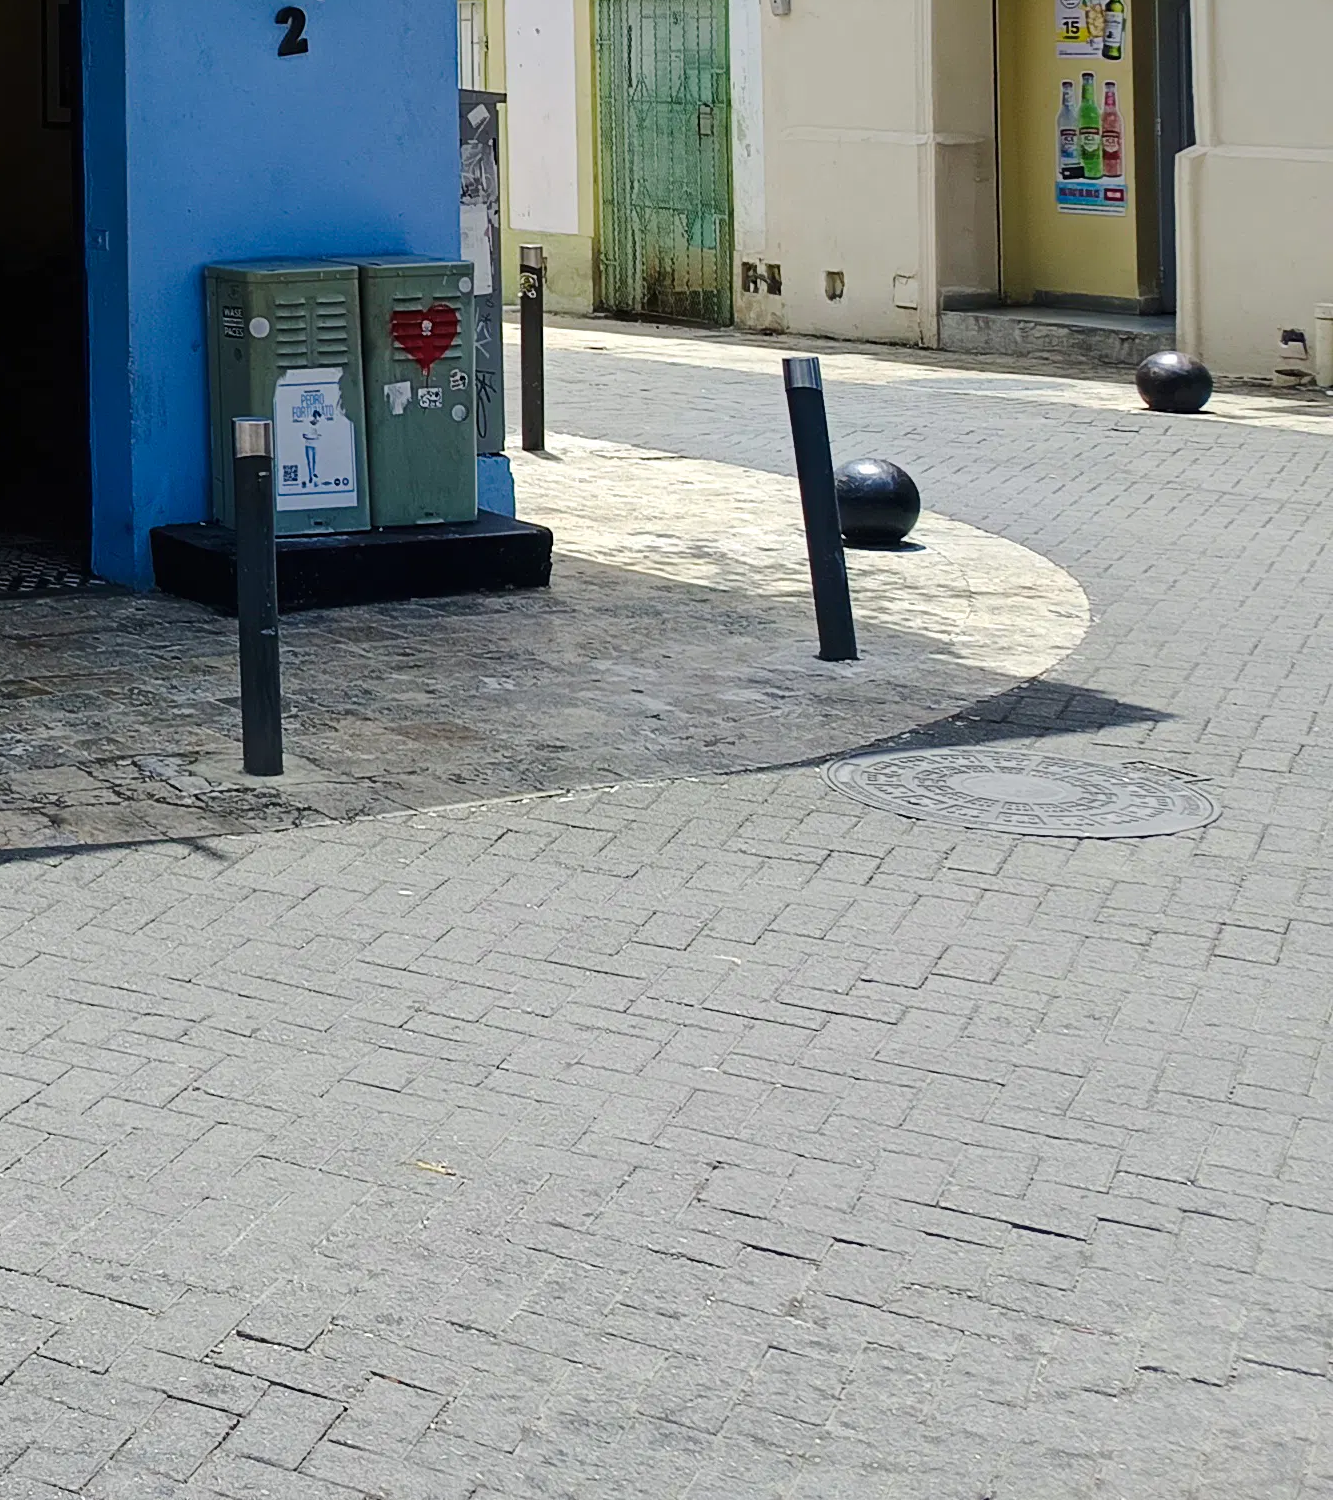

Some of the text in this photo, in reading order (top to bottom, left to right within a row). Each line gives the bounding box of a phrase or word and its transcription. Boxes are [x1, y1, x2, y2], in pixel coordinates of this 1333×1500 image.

[275, 6, 308, 57] 2
[1062, 20, 1080, 35] 15
[301, 393, 325, 406] PEDRO
